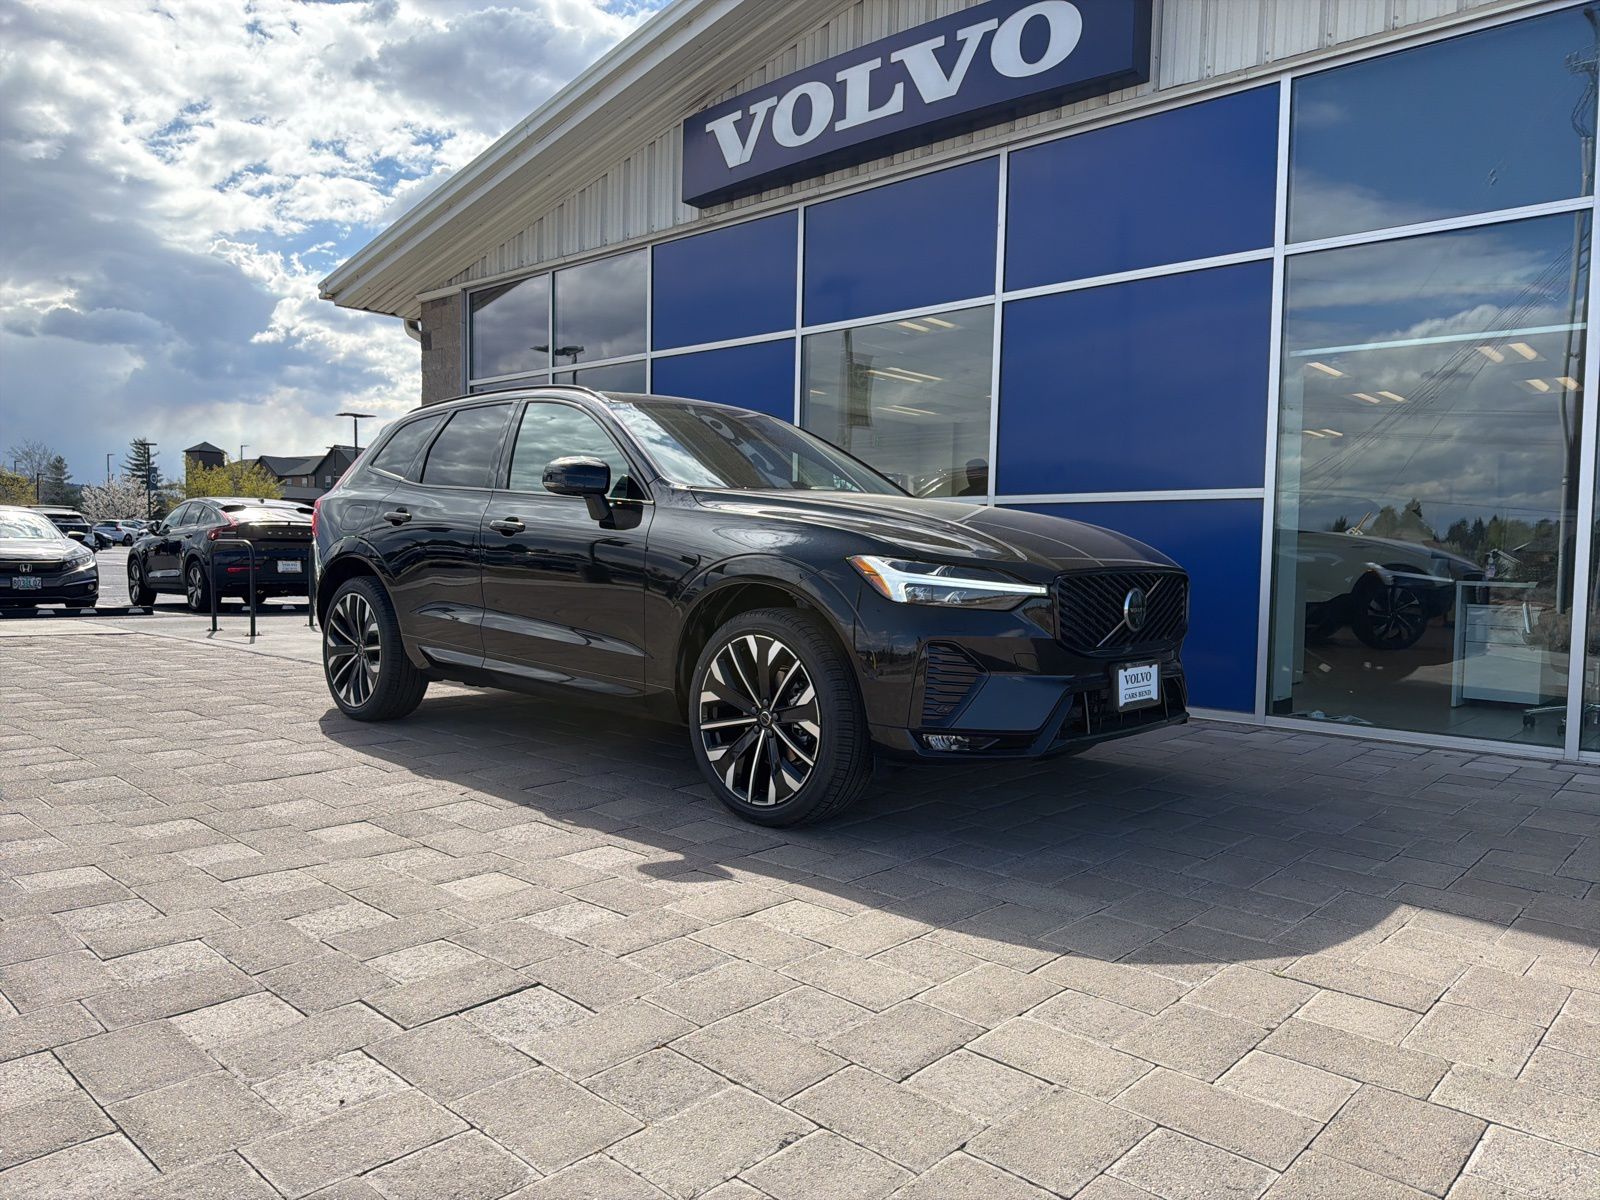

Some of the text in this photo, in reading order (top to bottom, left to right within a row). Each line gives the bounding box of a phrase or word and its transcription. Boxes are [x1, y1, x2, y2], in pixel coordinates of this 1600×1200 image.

[705, 0, 1083, 169] VOLVO
[1124, 671, 1152, 685] VOLVO
[1124, 689, 1152, 700] CARS BEND
